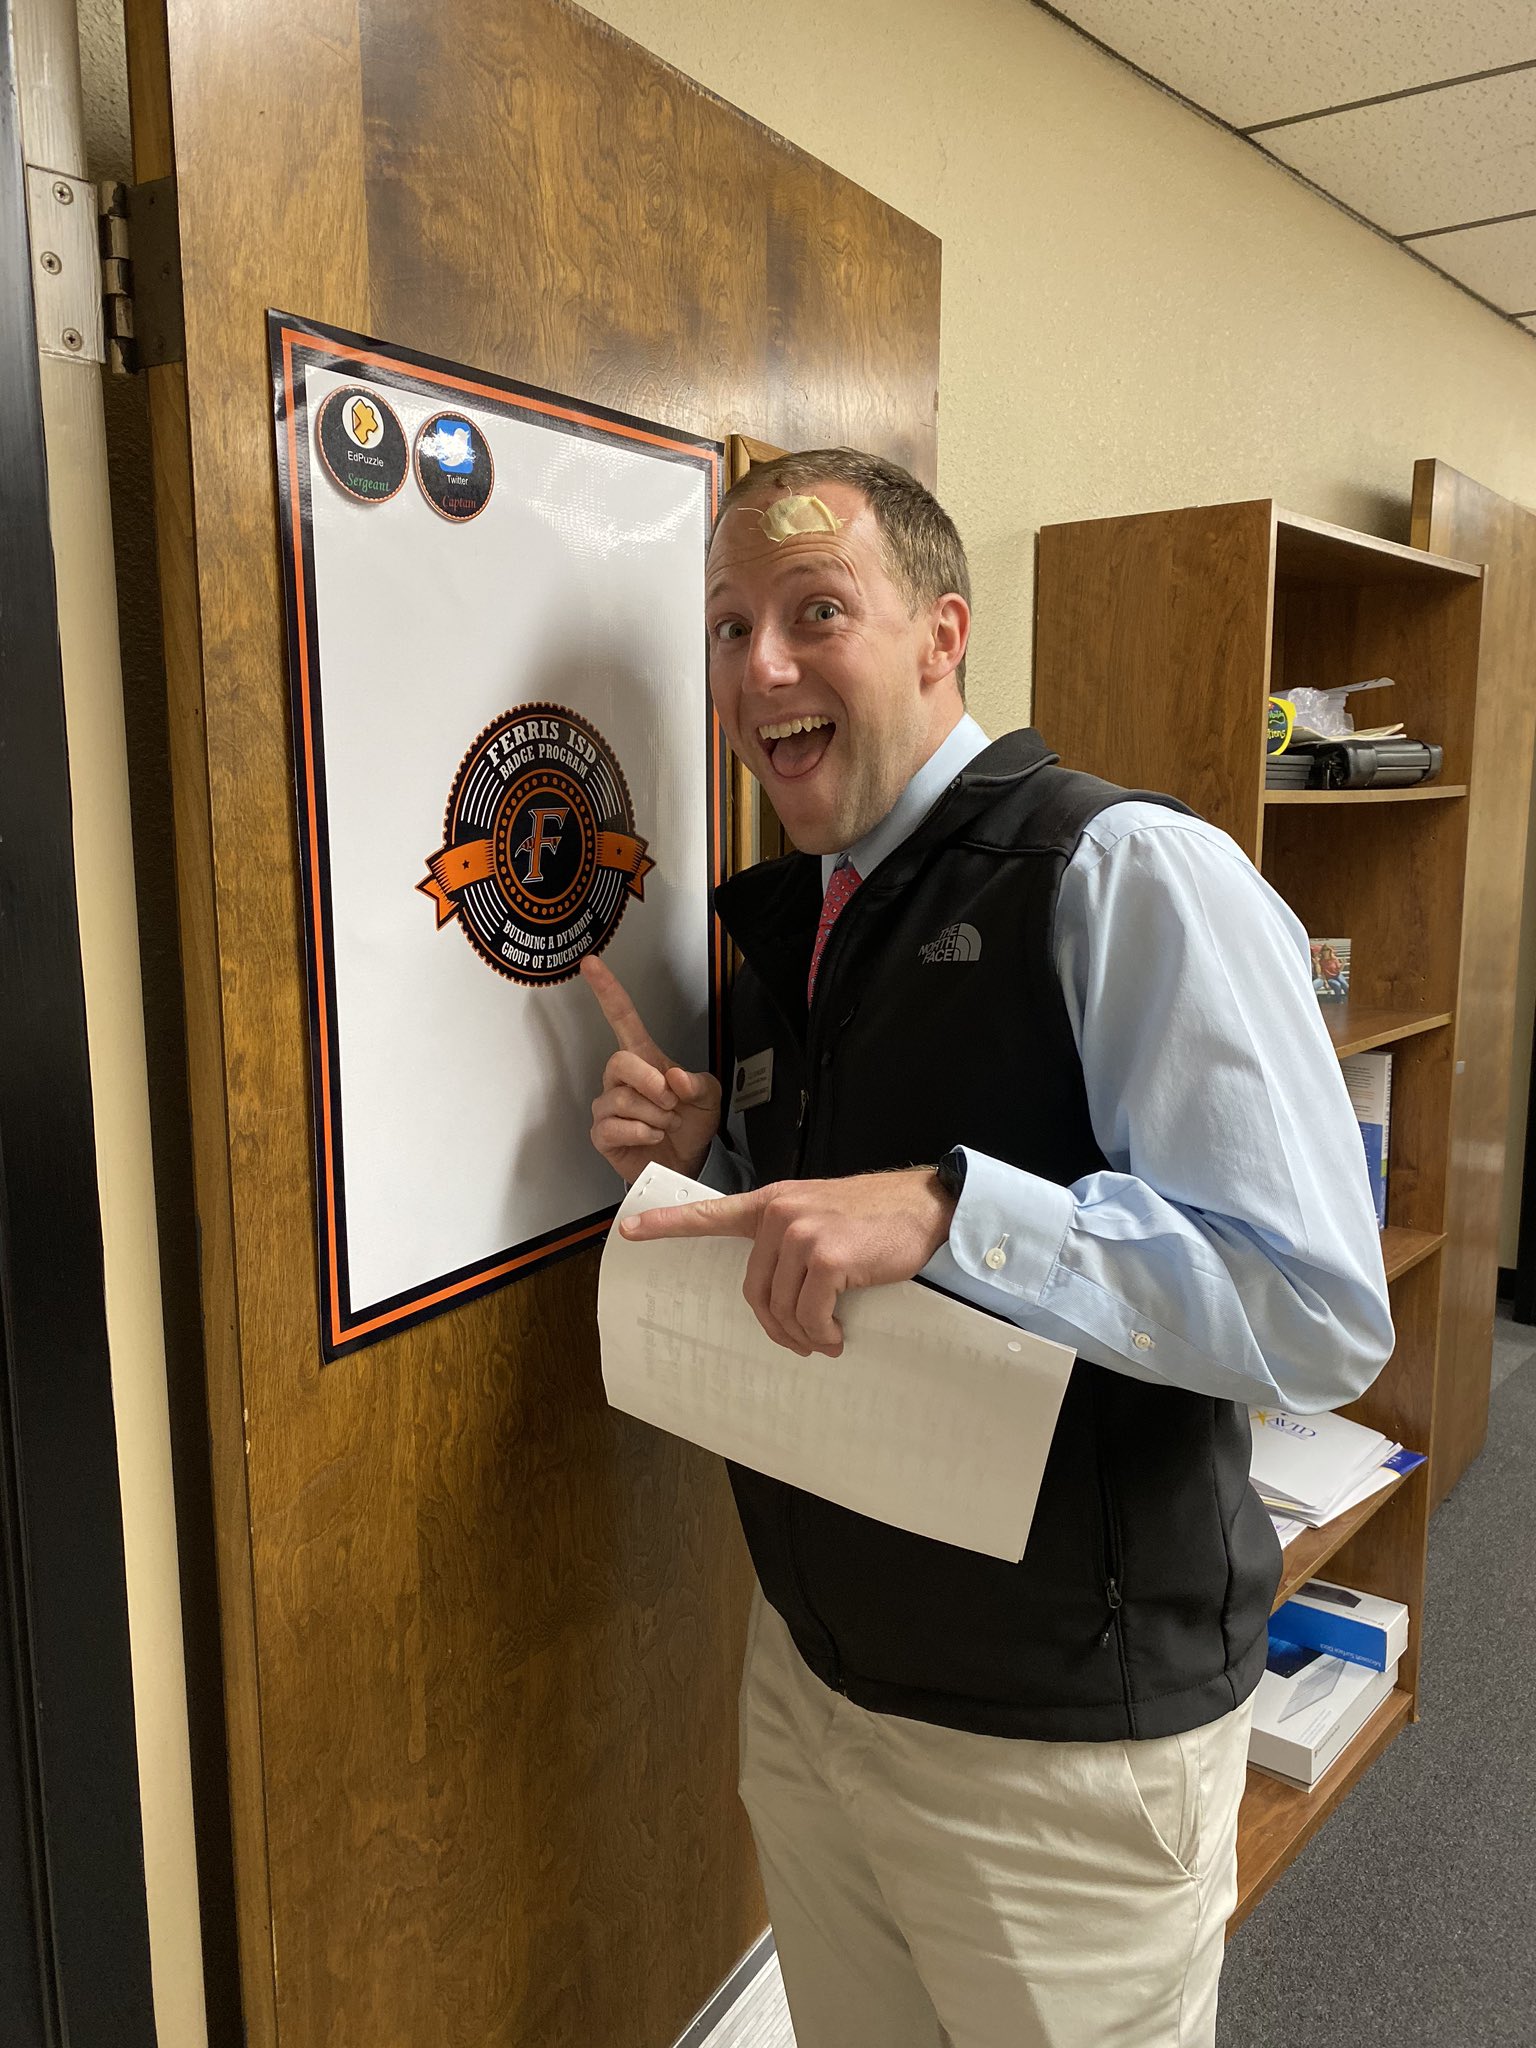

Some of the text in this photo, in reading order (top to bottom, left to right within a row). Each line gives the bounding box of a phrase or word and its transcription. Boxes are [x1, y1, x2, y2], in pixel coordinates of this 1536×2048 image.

[347, 450, 384, 467] EdPuzzle
[346, 472, 390, 493] Sergeant
[446, 474, 469, 486] Twitter
[442, 495, 477, 511] Captain
[486, 720, 597, 768] FERRIS ISD
[499, 743, 589, 781] BADGE PROGRAM
[502, 908, 594, 950] BUILDING A DYNAMIC
[939, 923, 960, 940] THE
[501, 931, 593, 969] GROUP OF EDUCATORS
[918, 936, 956, 957] NORTH
[922, 949, 955, 965] FACE
